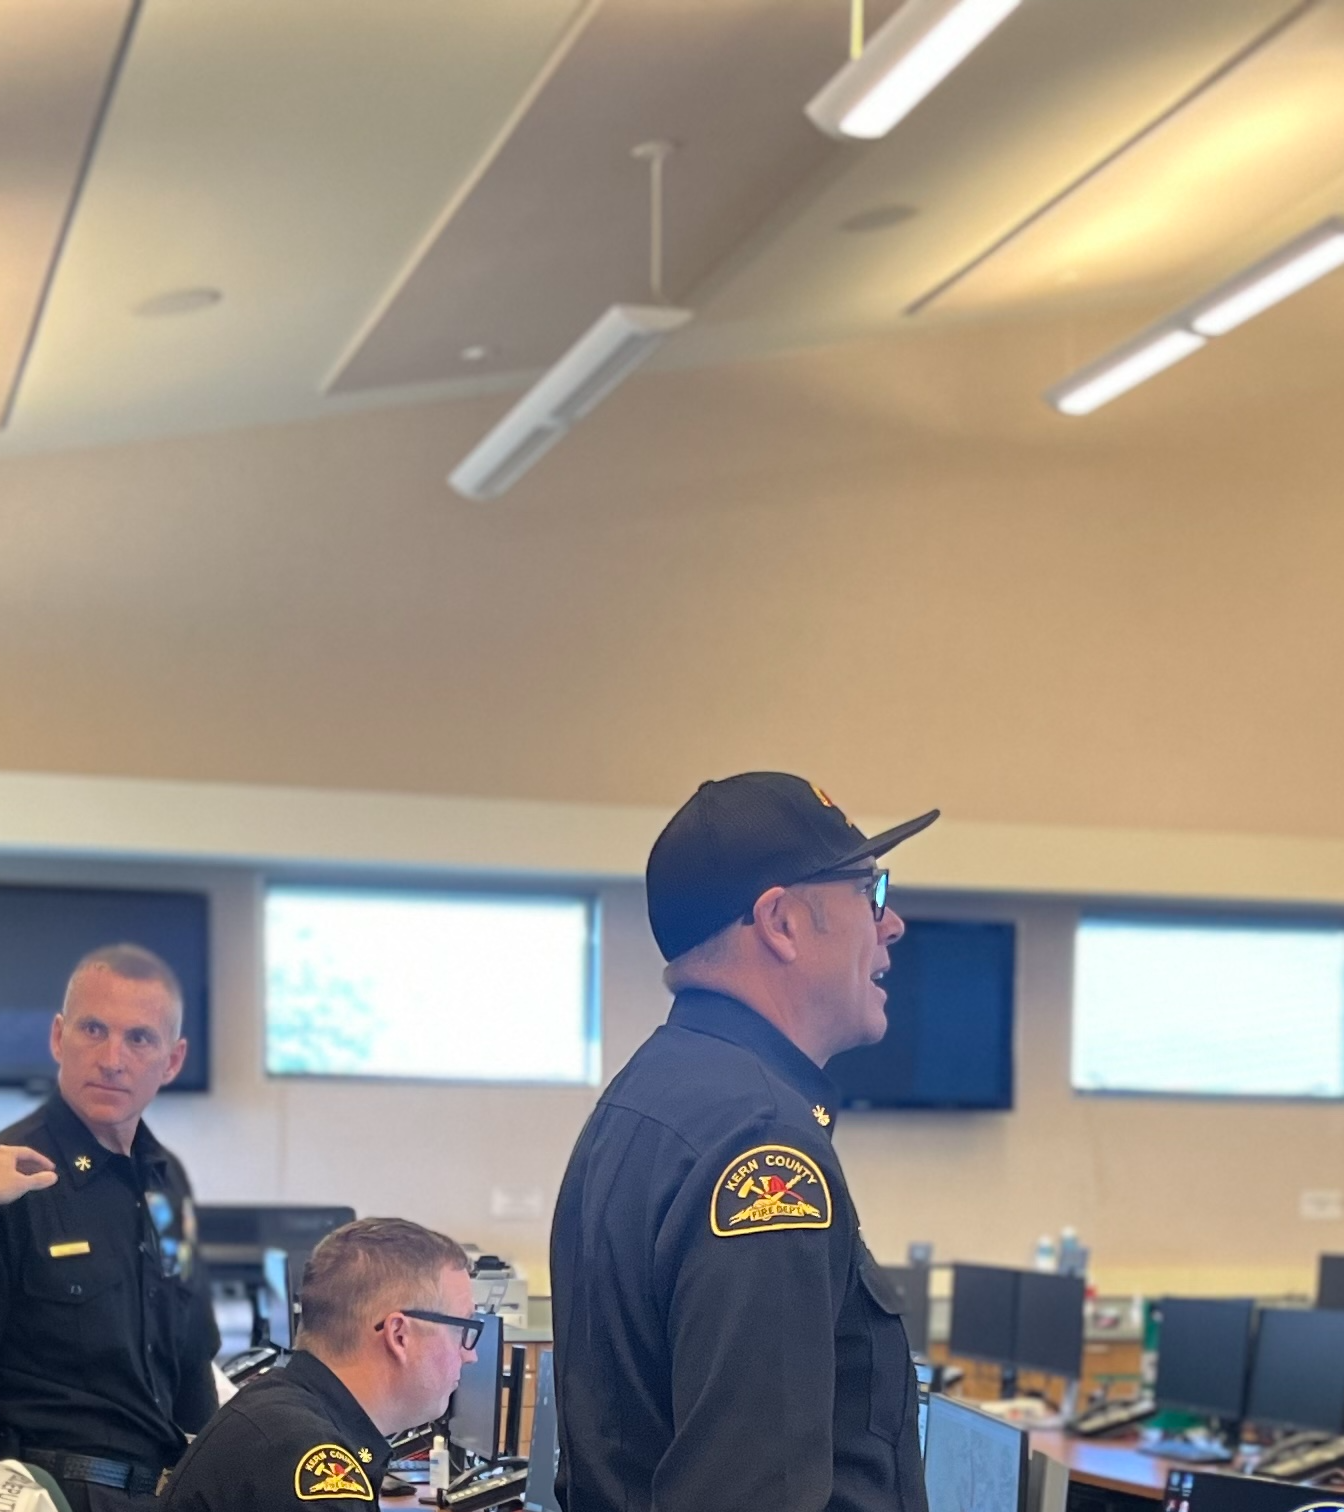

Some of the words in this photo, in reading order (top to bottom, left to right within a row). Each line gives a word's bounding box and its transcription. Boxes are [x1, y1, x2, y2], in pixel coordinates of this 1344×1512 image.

[725, 1159, 759, 1191] KERN
[765, 1155, 818, 1185] COUNTY
[752, 1207, 774, 1219] FIRE
